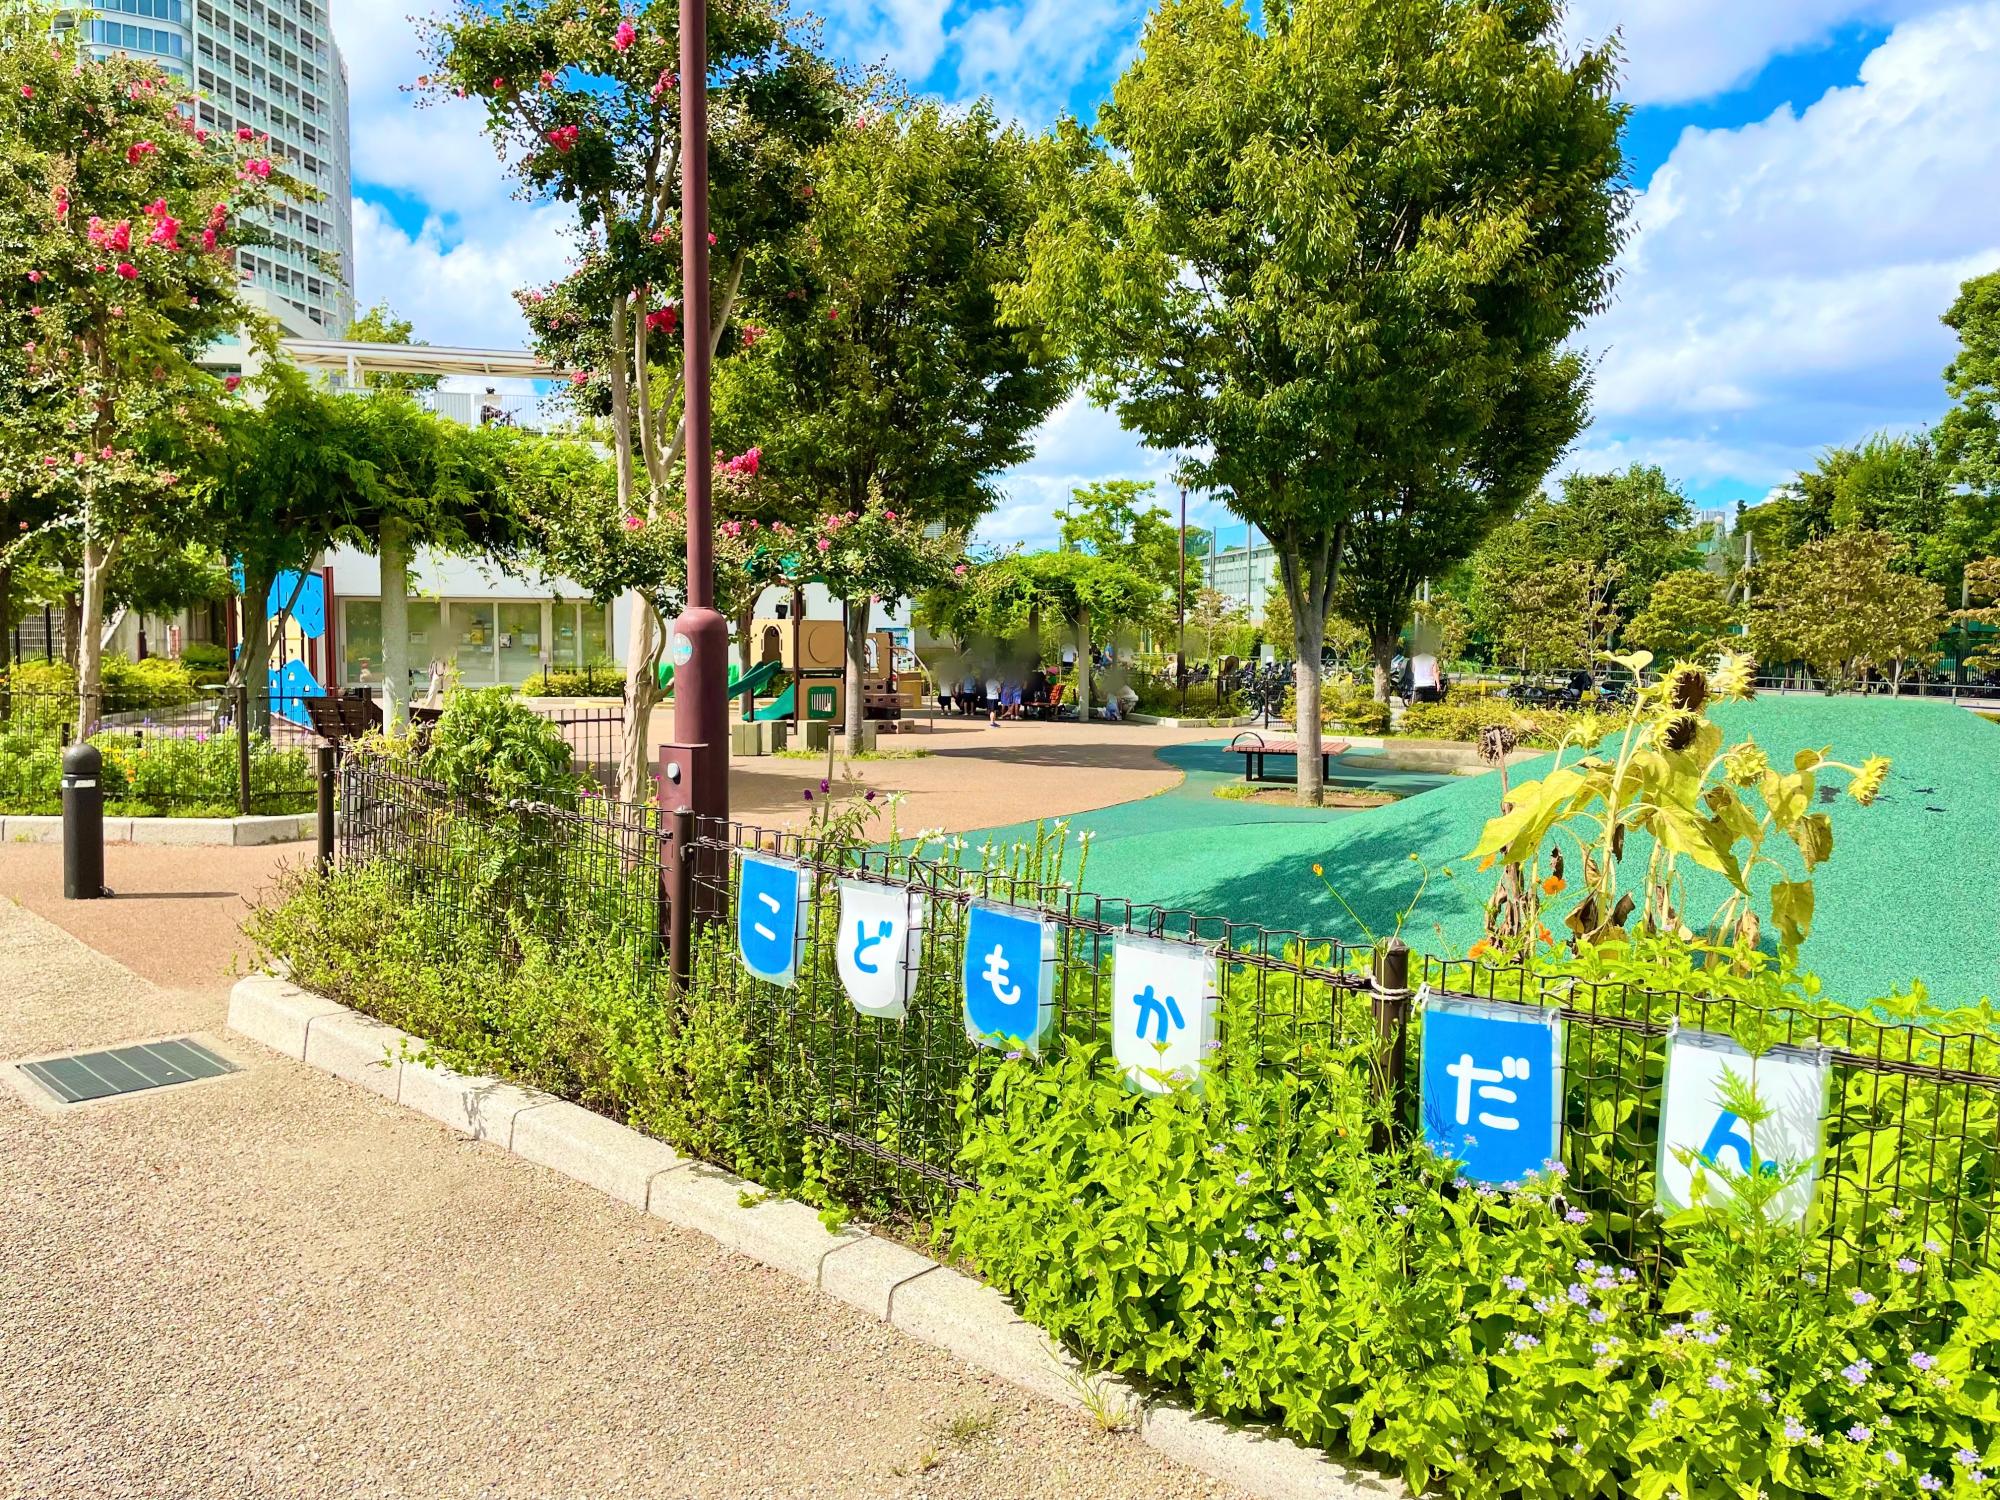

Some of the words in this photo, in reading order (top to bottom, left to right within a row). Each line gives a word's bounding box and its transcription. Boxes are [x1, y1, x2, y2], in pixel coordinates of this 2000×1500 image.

[754, 892, 781, 941] こ
[853, 919, 893, 975] ど
[982, 944, 1021, 1005] も
[1132, 984, 1186, 1042] か
[1446, 1053, 1530, 1131] だ
[1699, 1109, 1777, 1176] ん
